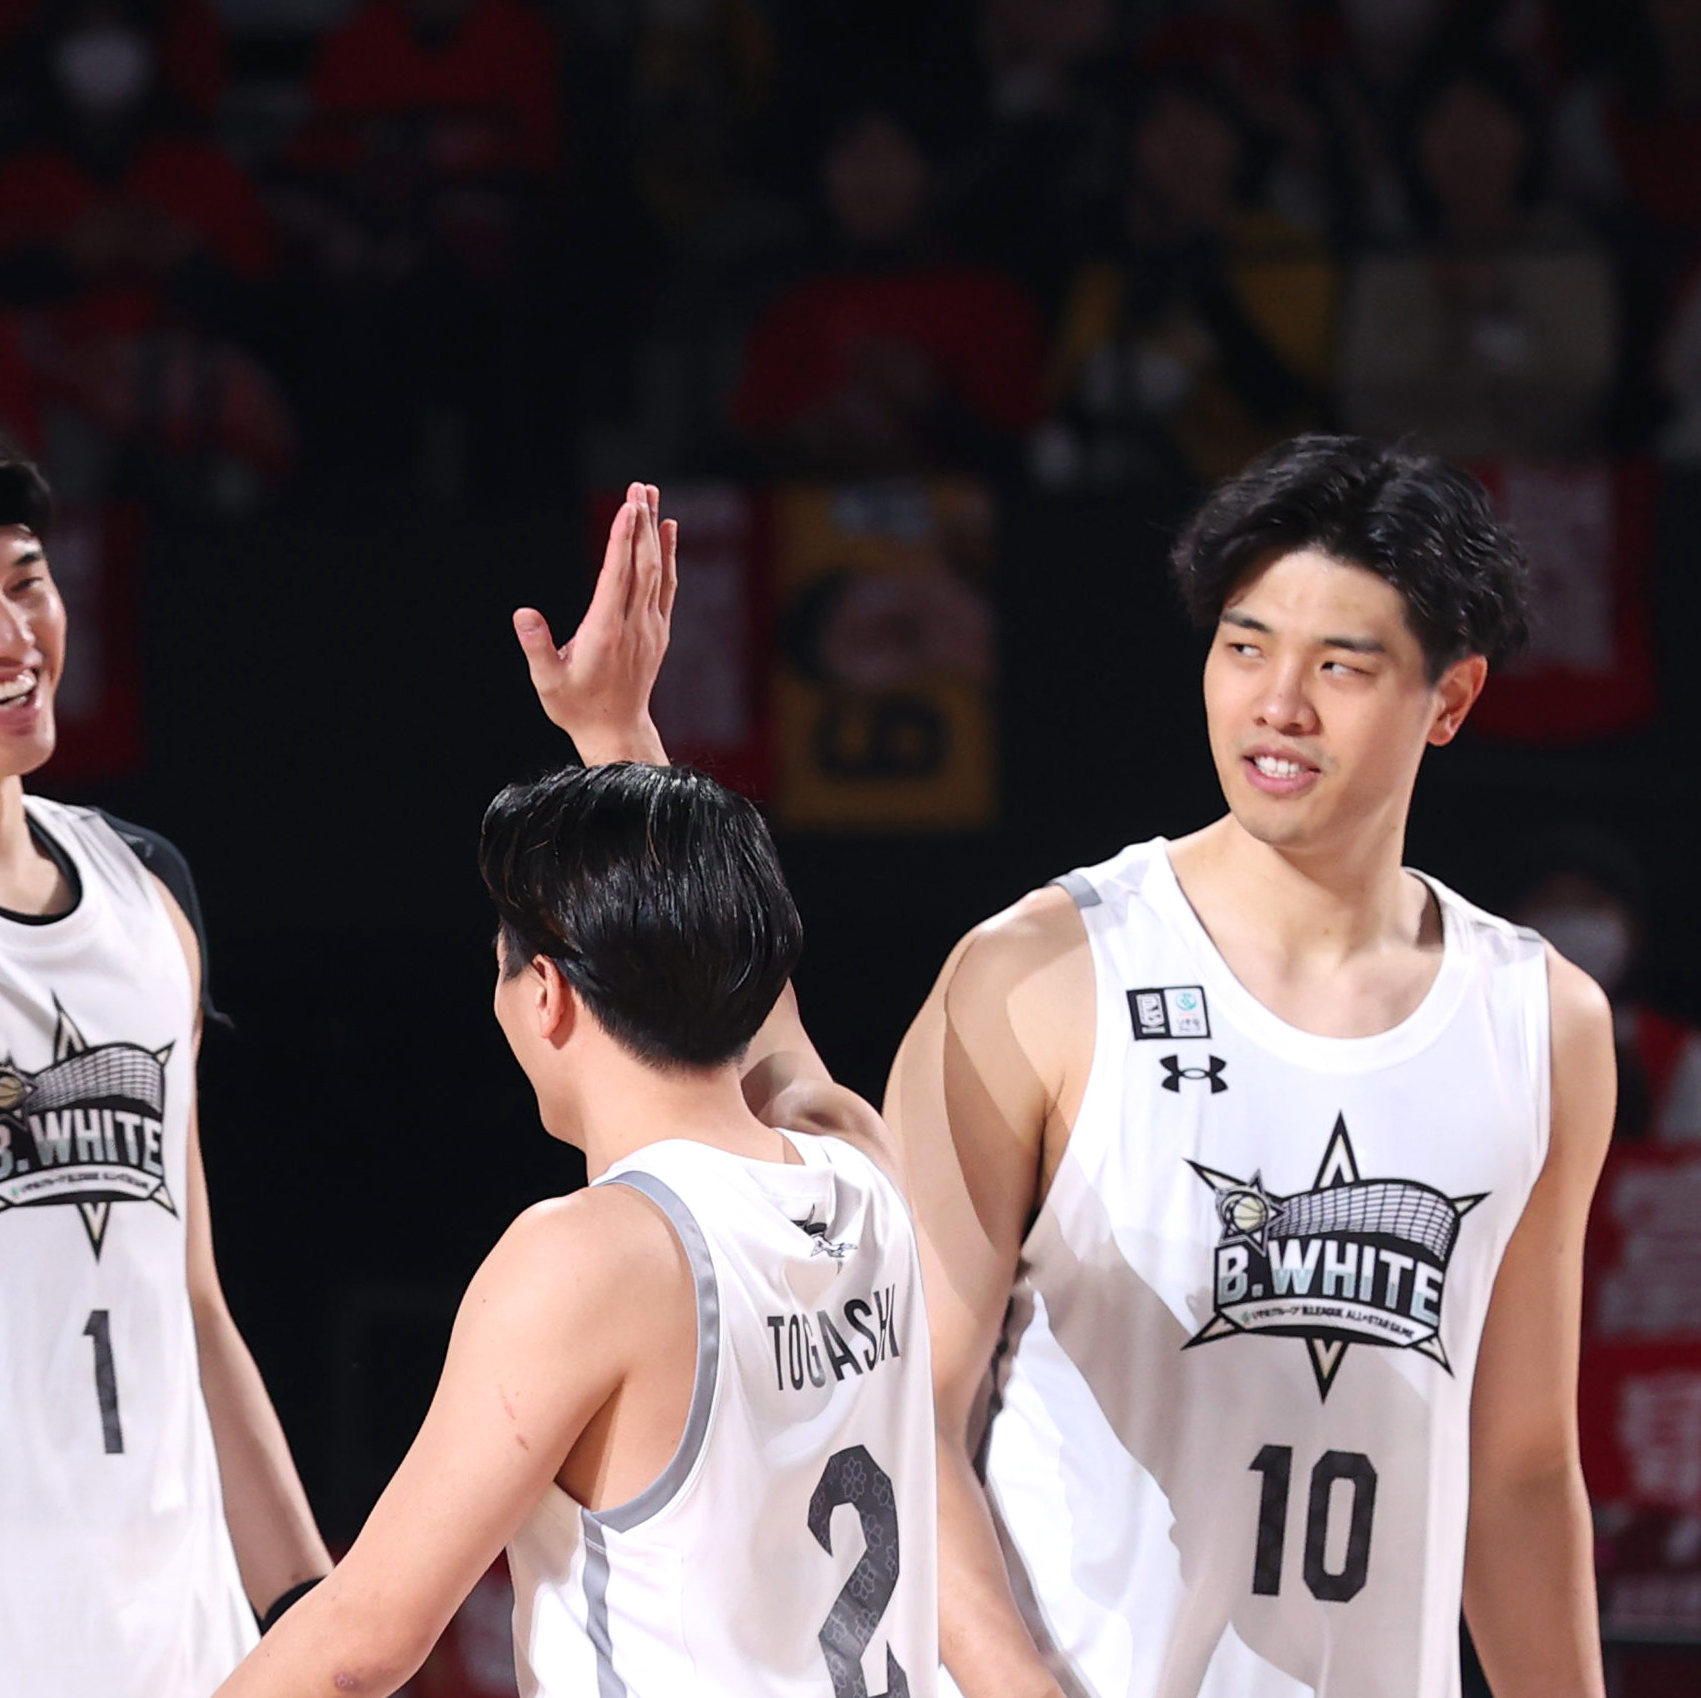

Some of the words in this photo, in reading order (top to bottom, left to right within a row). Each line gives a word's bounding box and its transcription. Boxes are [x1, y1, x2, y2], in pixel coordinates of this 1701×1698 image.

[1217, 1238, 1444, 1327] B.WHITE
[82, 1309, 125, 1455] 1
[1248, 1443, 1379, 1603] 10
